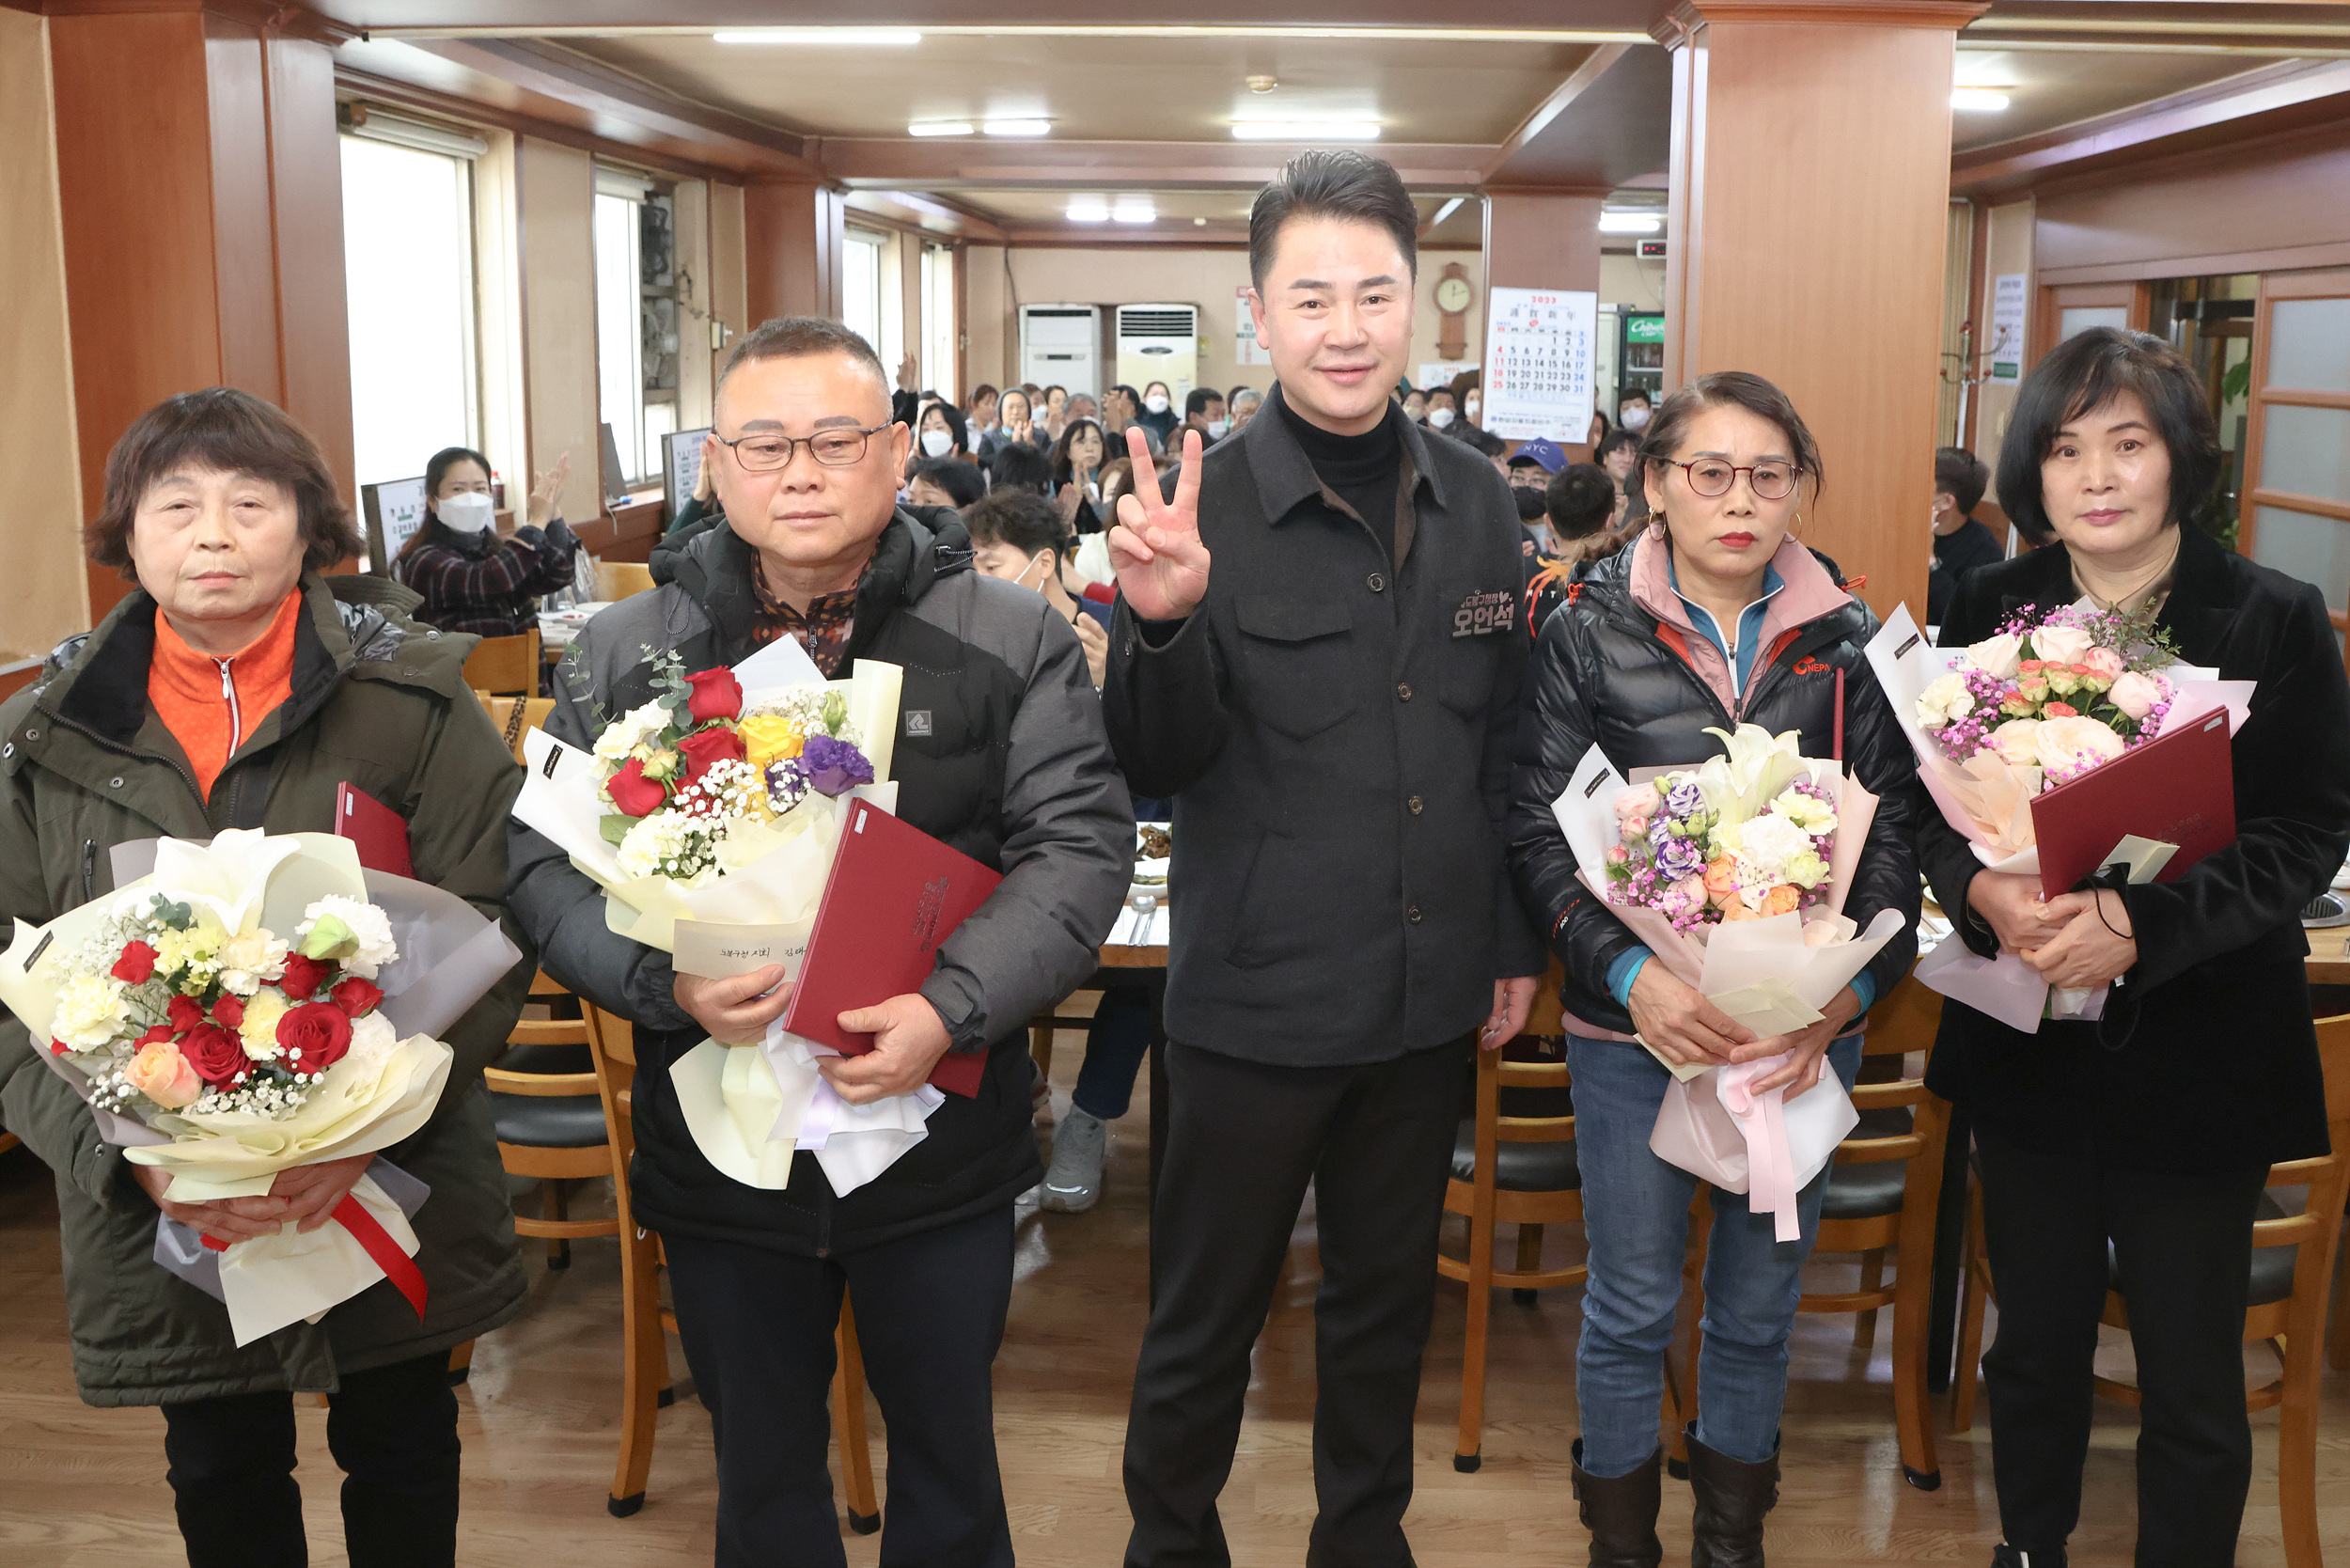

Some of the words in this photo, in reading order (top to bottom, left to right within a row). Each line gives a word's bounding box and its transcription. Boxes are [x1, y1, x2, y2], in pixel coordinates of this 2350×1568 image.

[1531, 295, 1557, 305] 2023
[1553, 337, 1557, 345] 1
[1495, 357, 1504, 366] 11
[1508, 357, 1517, 366] 12
[1522, 358, 1530, 367] 13
[1562, 360, 1571, 368] 16
[1508, 369, 1517, 378] 19
[1534, 370, 1543, 379] 21
[1547, 371, 1558, 380] 22
[1493, 381, 1503, 389] 25
[1507, 381, 1516, 389] 26
[1559, 384, 1570, 392] 30
[1524, 444, 1549, 455] NYC
[1452, 603, 1514, 637] 오언석
[1807, 663, 1831, 672] NEPA
